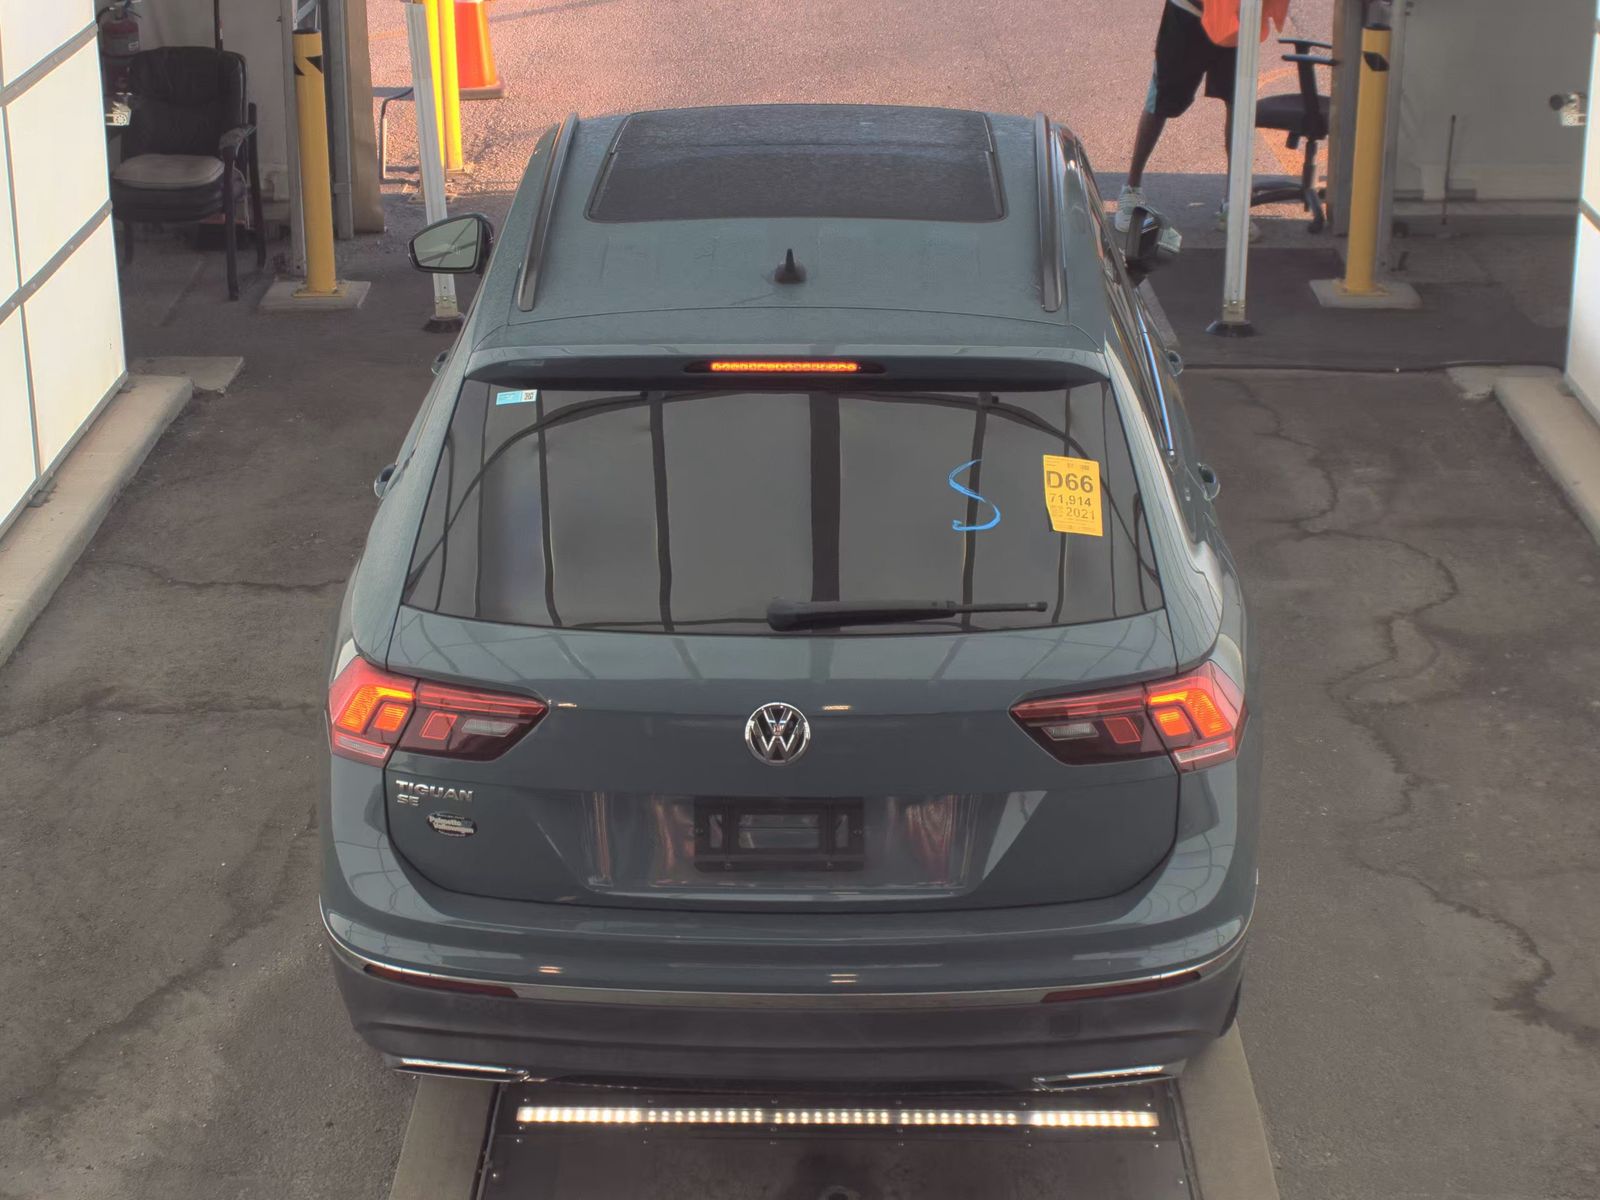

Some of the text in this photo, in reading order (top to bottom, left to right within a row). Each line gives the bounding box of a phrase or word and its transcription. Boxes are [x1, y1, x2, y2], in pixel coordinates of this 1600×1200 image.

[1046, 470, 1094, 493] D66
[1049, 493, 1091, 507] 71,914
[1066, 506, 1095, 520] 2021
[395, 780, 474, 801] TIGUAN
[396, 793, 420, 807] SE
